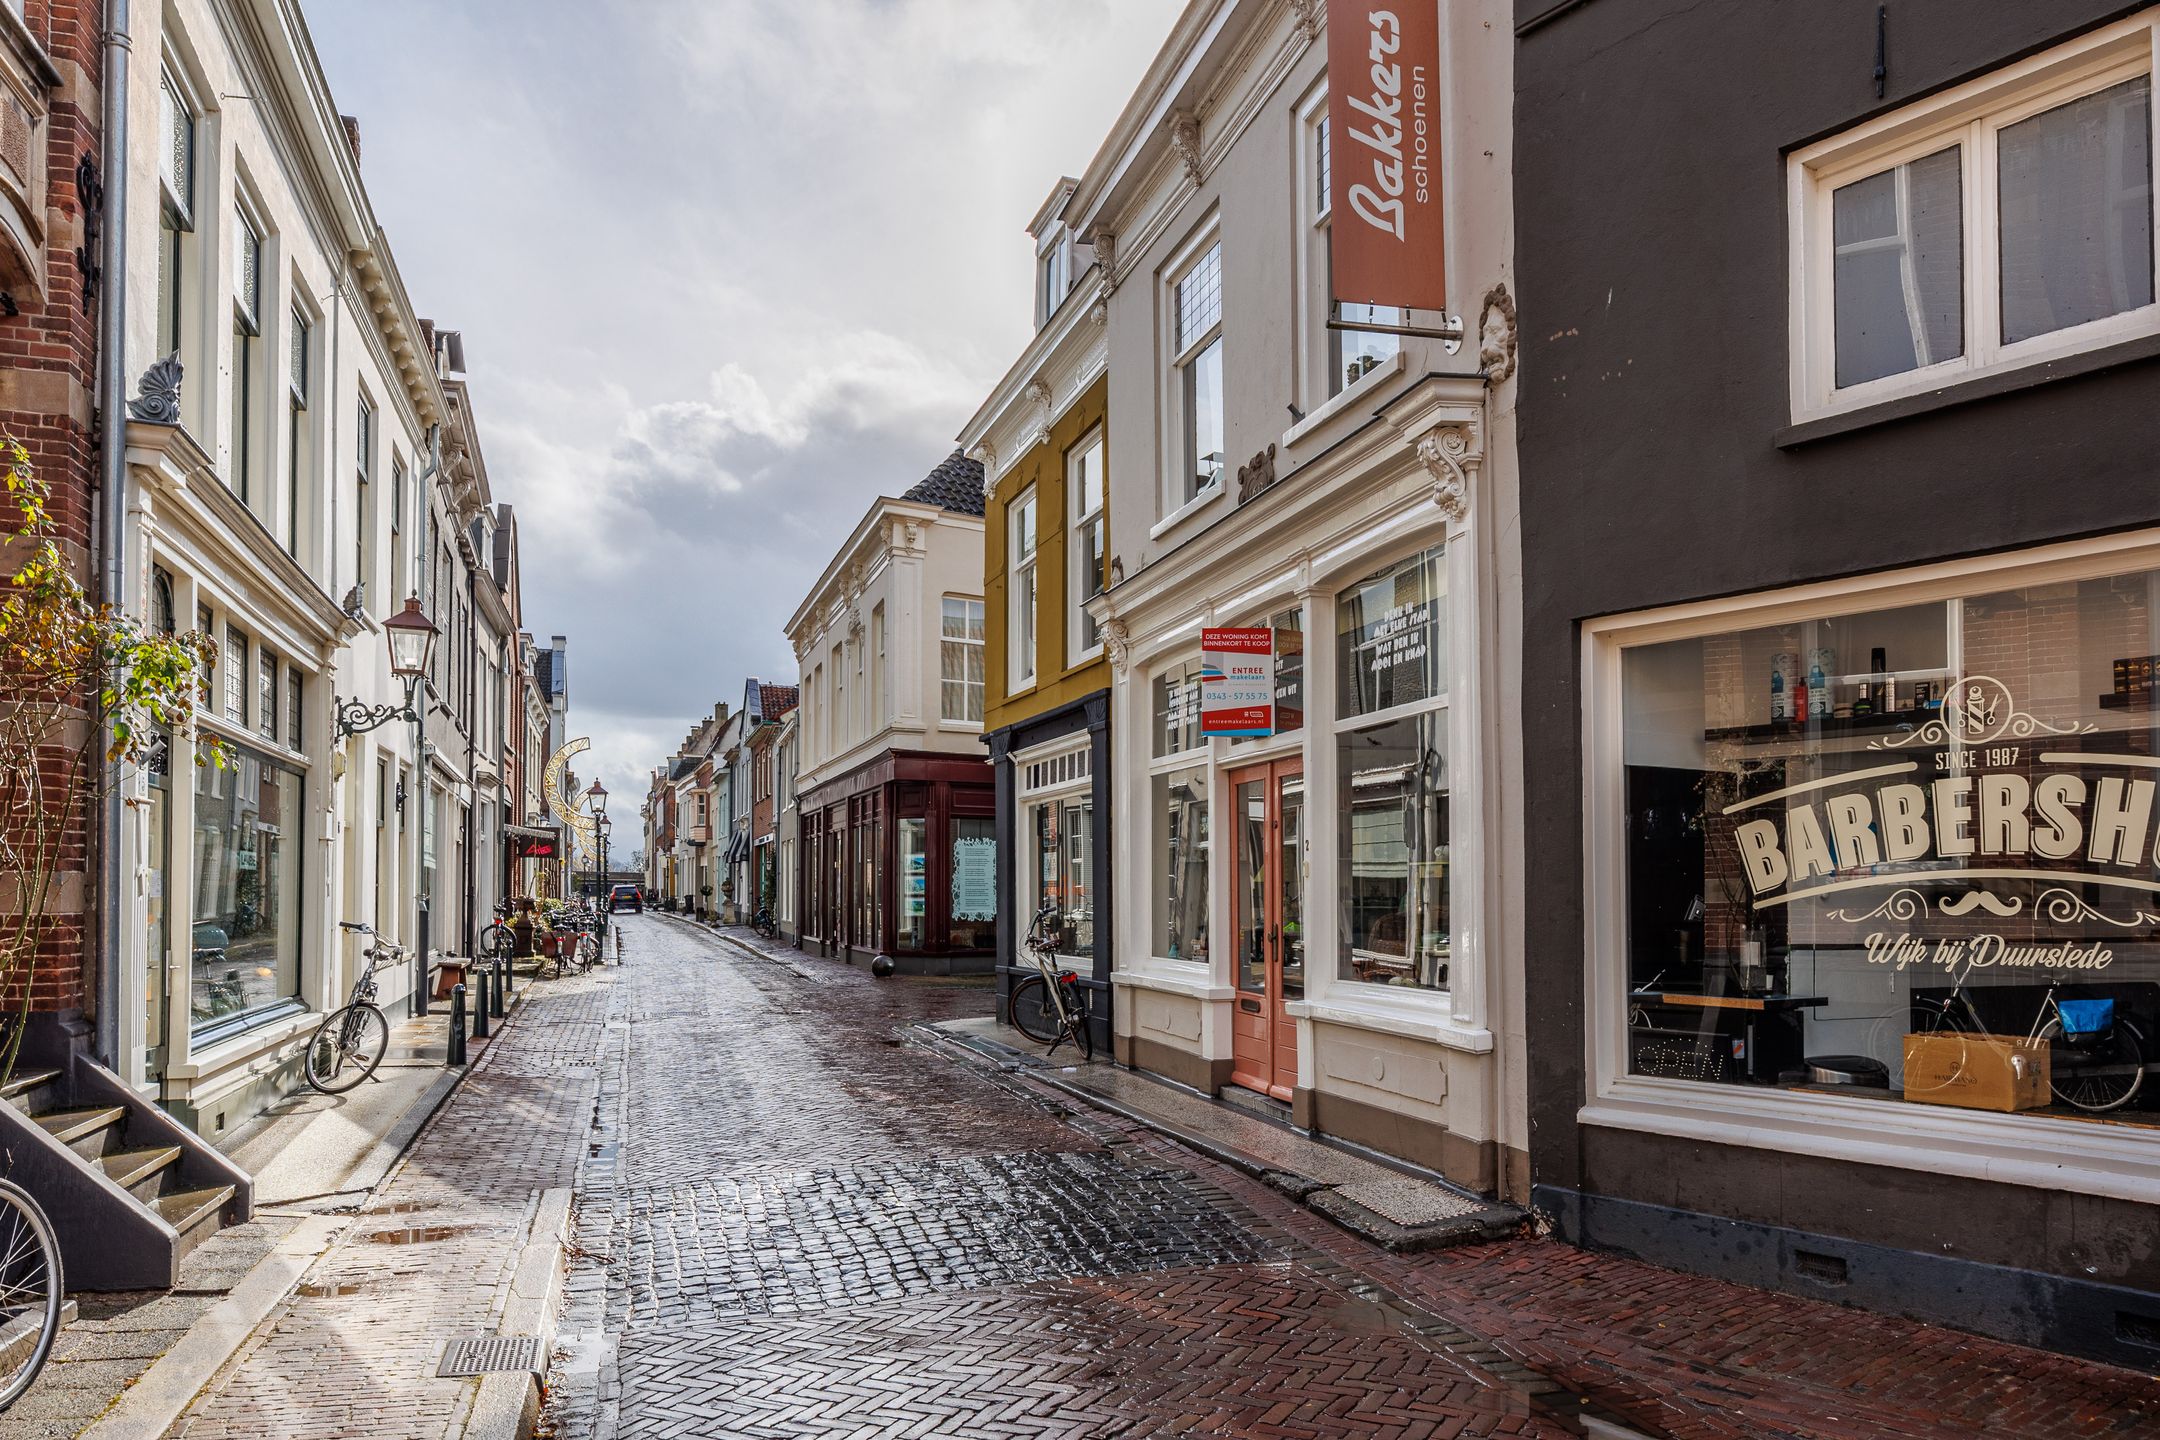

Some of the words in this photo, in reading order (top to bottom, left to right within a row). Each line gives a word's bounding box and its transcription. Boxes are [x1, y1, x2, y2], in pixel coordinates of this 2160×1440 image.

[1347, 10, 1405, 243] Bakkers
[1411, 65, 1428, 204] schoenen
[1411, 632, 1419, 645] IK
[1935, 750, 1977, 770] SINCE
[1985, 747, 2019, 767] 1987
[1735, 773, 2160, 896] BARBERSH
[1864, 932, 1929, 971] Wijk
[1932, 938, 1967, 973] bij
[1969, 934, 2113, 970] Duurstede
[1638, 1046, 1724, 1080] OPEN
